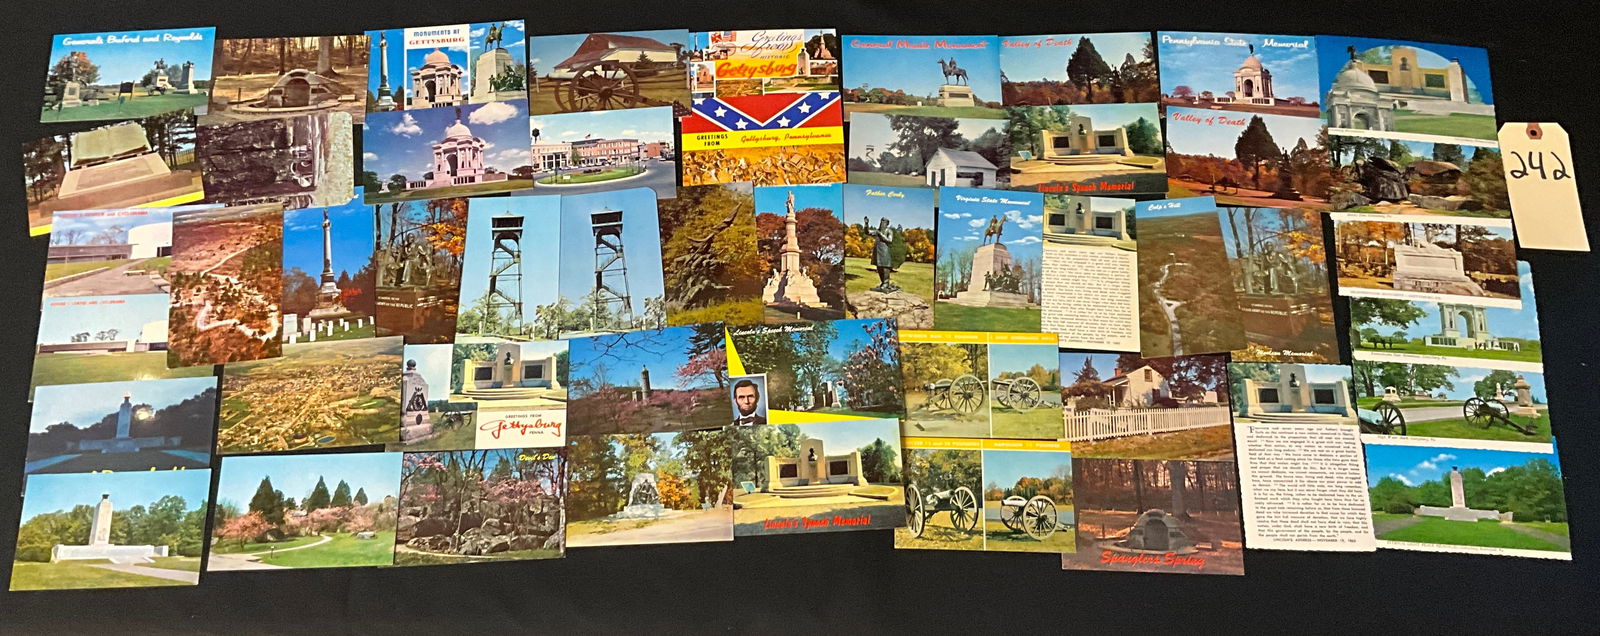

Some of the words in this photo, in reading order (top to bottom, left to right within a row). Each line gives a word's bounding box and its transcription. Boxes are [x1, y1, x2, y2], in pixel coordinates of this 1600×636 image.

[107, 34, 140, 44] Buford
[143, 35, 160, 43] and
[163, 32, 203, 43] Reynolds
[409, 37, 465, 46] GETTYSBURG
[1002, 40, 1030, 48] Valley
[1033, 40, 1042, 48] of
[1046, 38, 1073, 47] Death
[1162, 35, 1221, 47] Pennsylvania
[1224, 36, 1247, 47] State
[1262, 38, 1309, 49] Memorial
[850, 40, 893, 49] General
[716, 62, 797, 79] Gettysburg
[1172, 112, 1201, 125] Valley
[1205, 117, 1214, 126] of
[1218, 116, 1246, 127] Death
[784, 132, 832, 142] Pennsylvania
[1510, 151, 1571, 180] 242
[1100, 181, 1136, 192] Memorial
[1282, 349, 1314, 357] Memorial
[479, 418, 562, 440] Gettysburg
[832, 514, 872, 527] Memorial
[1163, 552, 1205, 569] Spring
